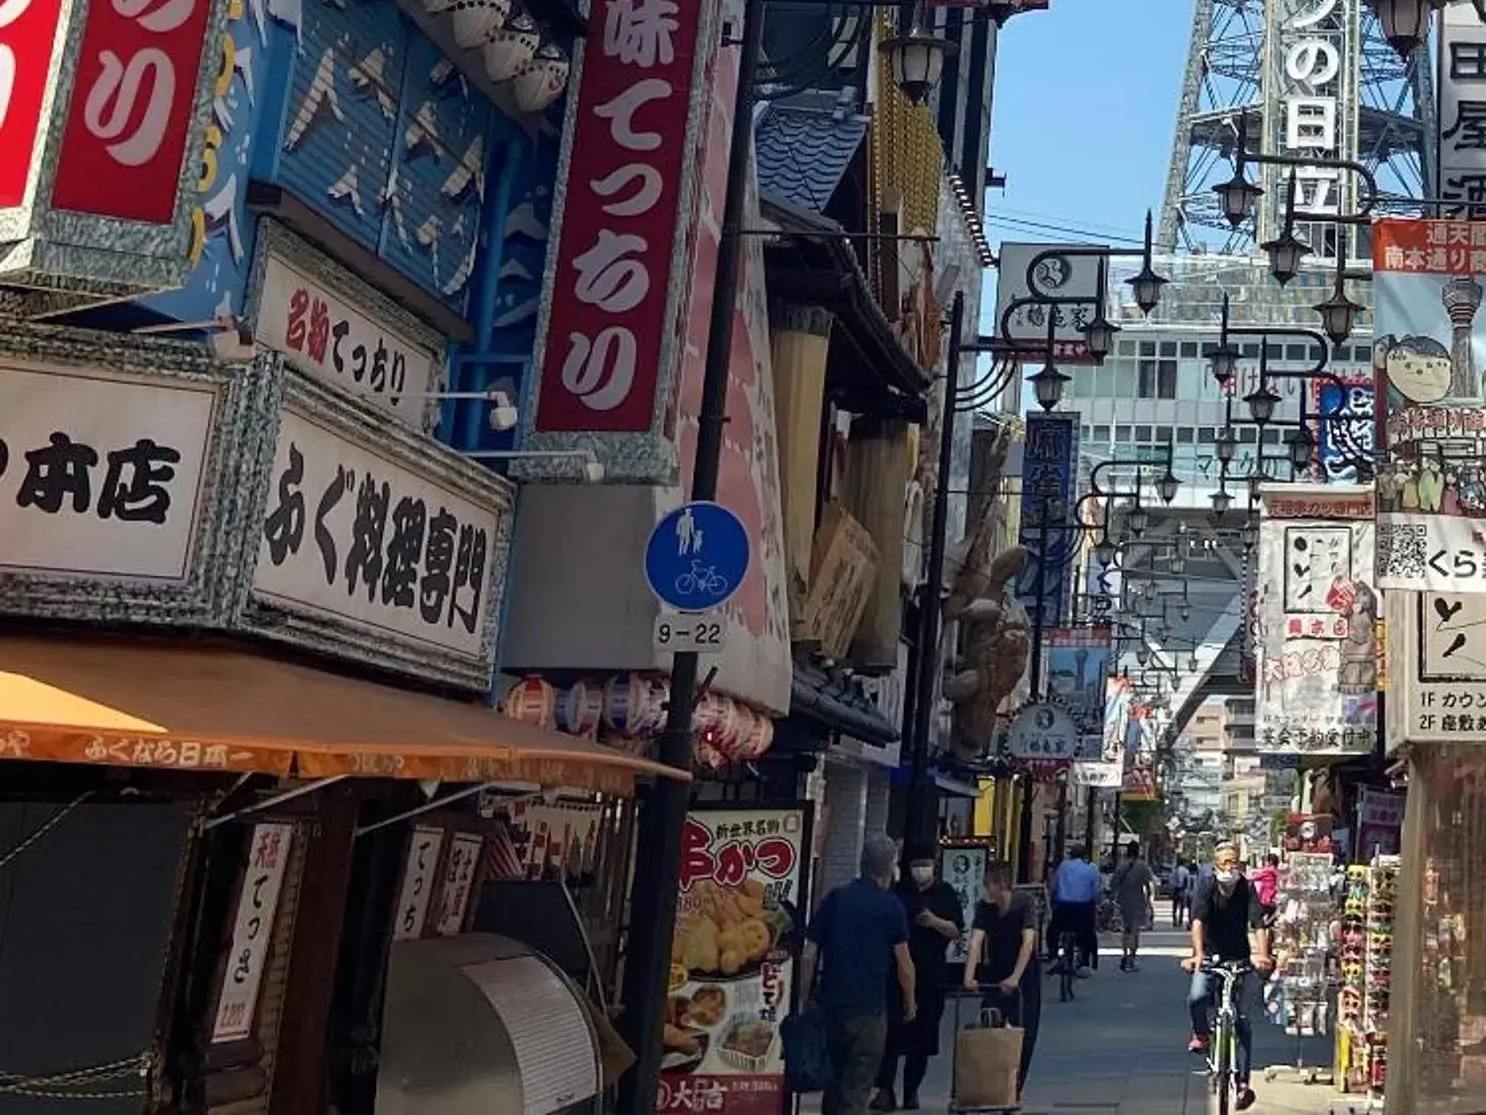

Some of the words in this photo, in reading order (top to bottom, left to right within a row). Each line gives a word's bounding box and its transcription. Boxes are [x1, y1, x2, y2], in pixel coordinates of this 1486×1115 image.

[285, 287, 405, 406] 名物てっちり
[0, 432, 181, 524] 本店
[264, 441, 487, 634] ふぐ料理専門
[658, 623, 721, 644] 9-22
[1420, 692, 1436, 706] 1F
[1420, 716, 1437, 730] 2F
